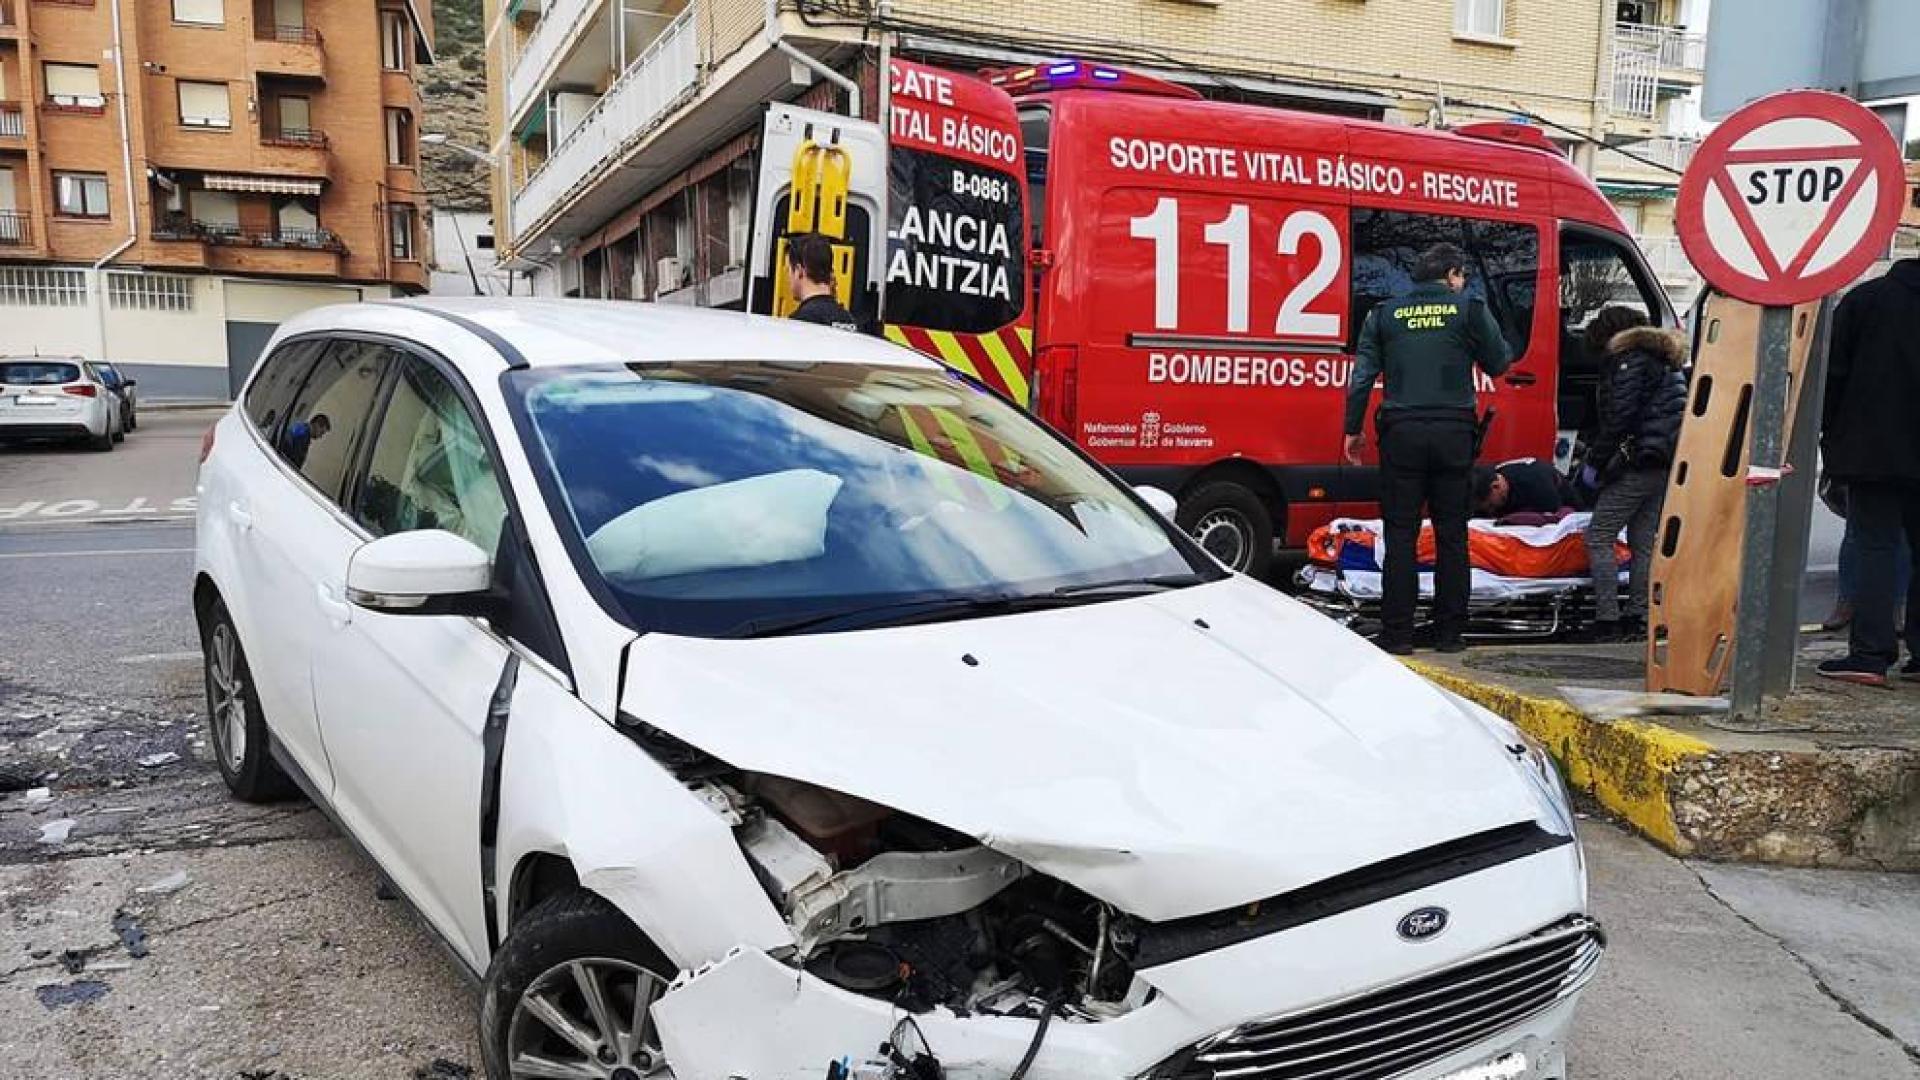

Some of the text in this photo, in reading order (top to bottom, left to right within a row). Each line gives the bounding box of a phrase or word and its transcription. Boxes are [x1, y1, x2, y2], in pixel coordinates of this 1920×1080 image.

[942, 113, 1017, 163] BÁSICO
[953, 170, 1009, 204] B-0861
[1110, 136, 1238, 178] SOPORTE
[1244, 150, 1311, 185] VITAL
[1317, 154, 1403, 194] BÁSICO
[1423, 172, 1519, 208] RESCATE
[1746, 166, 1844, 206] STOP
[887, 205, 1010, 259] ANCIA
[1130, 197, 1342, 337] 112
[1394, 304, 1458, 319] GUARDIA
[1408, 316, 1446, 329] CIVIL
